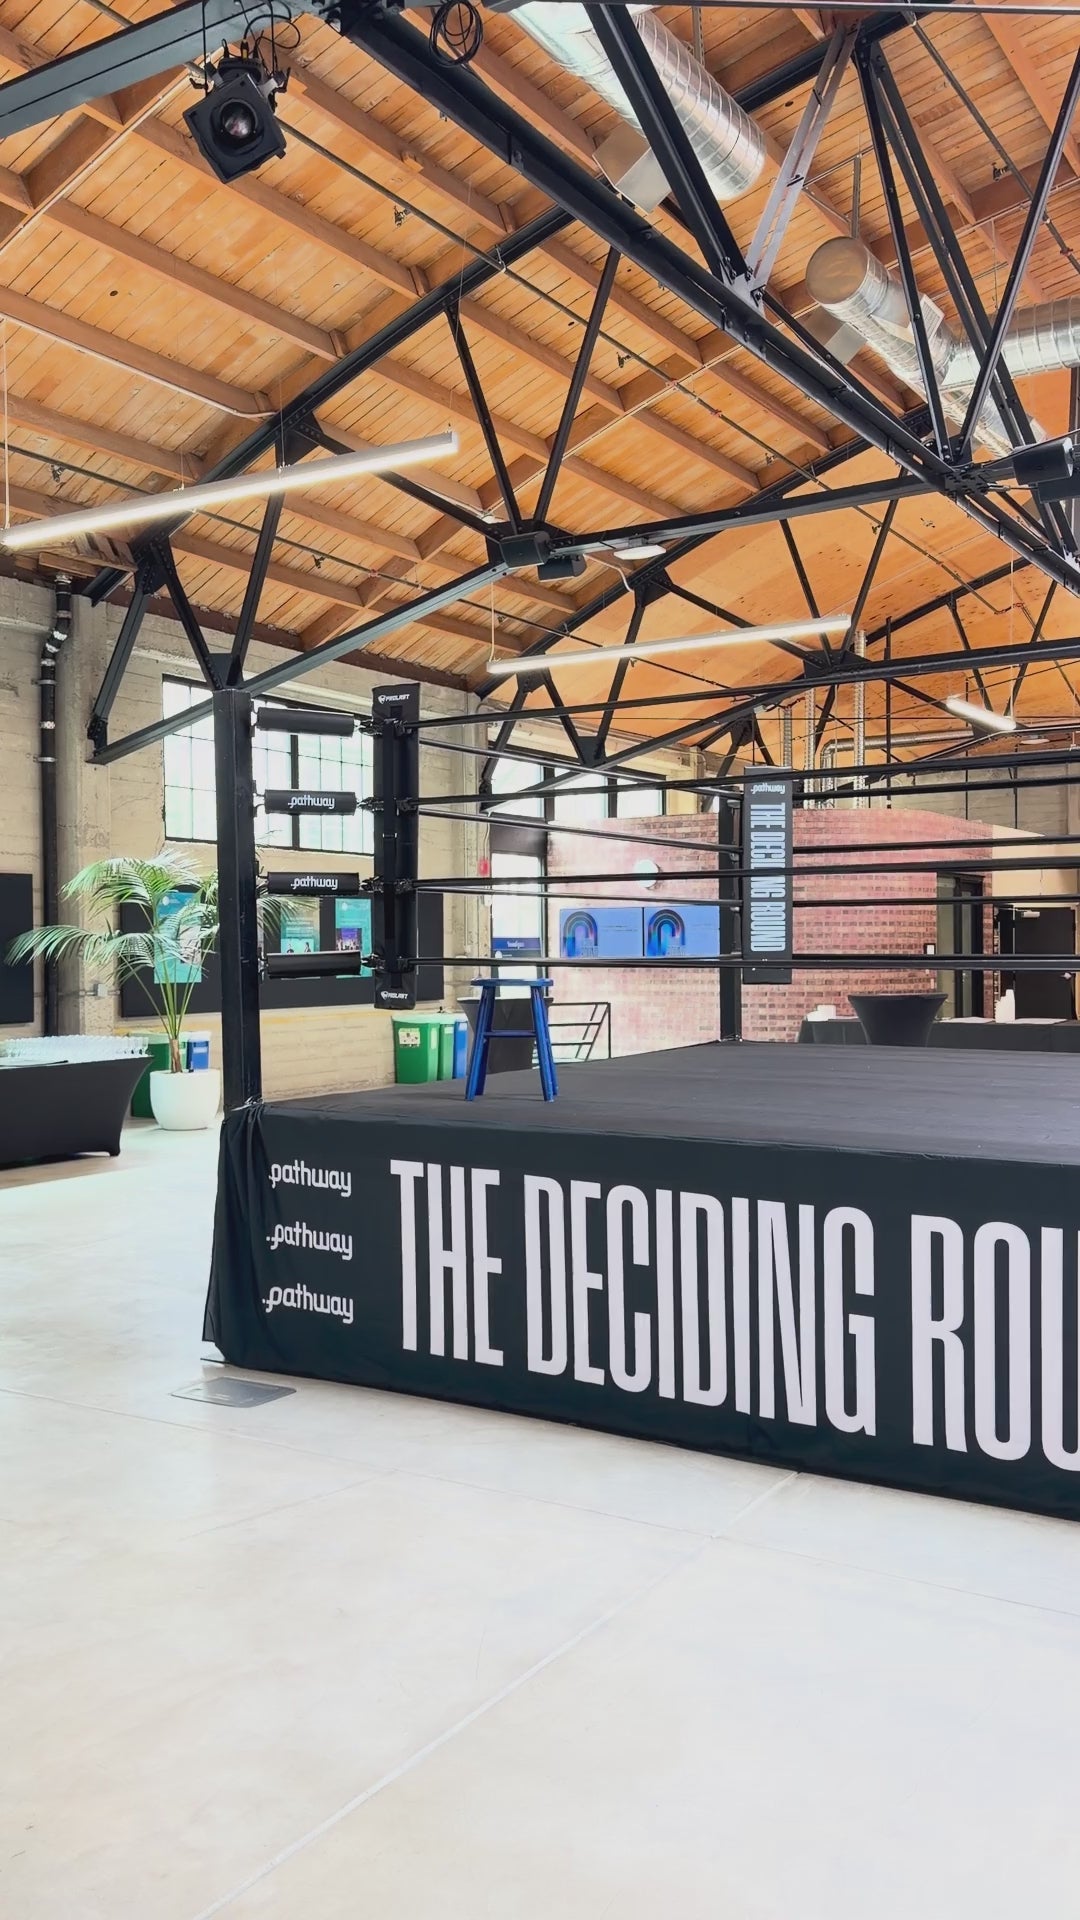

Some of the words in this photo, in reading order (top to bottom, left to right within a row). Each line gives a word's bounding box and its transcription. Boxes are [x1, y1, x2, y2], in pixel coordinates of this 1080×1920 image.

[750, 802, 786, 828] THE
[750, 832, 786, 898] DECIDNG
[750, 902, 786, 952] ROUND
[390, 1160, 504, 1367] THE
[524, 1175, 876, 1436] DECIDING
